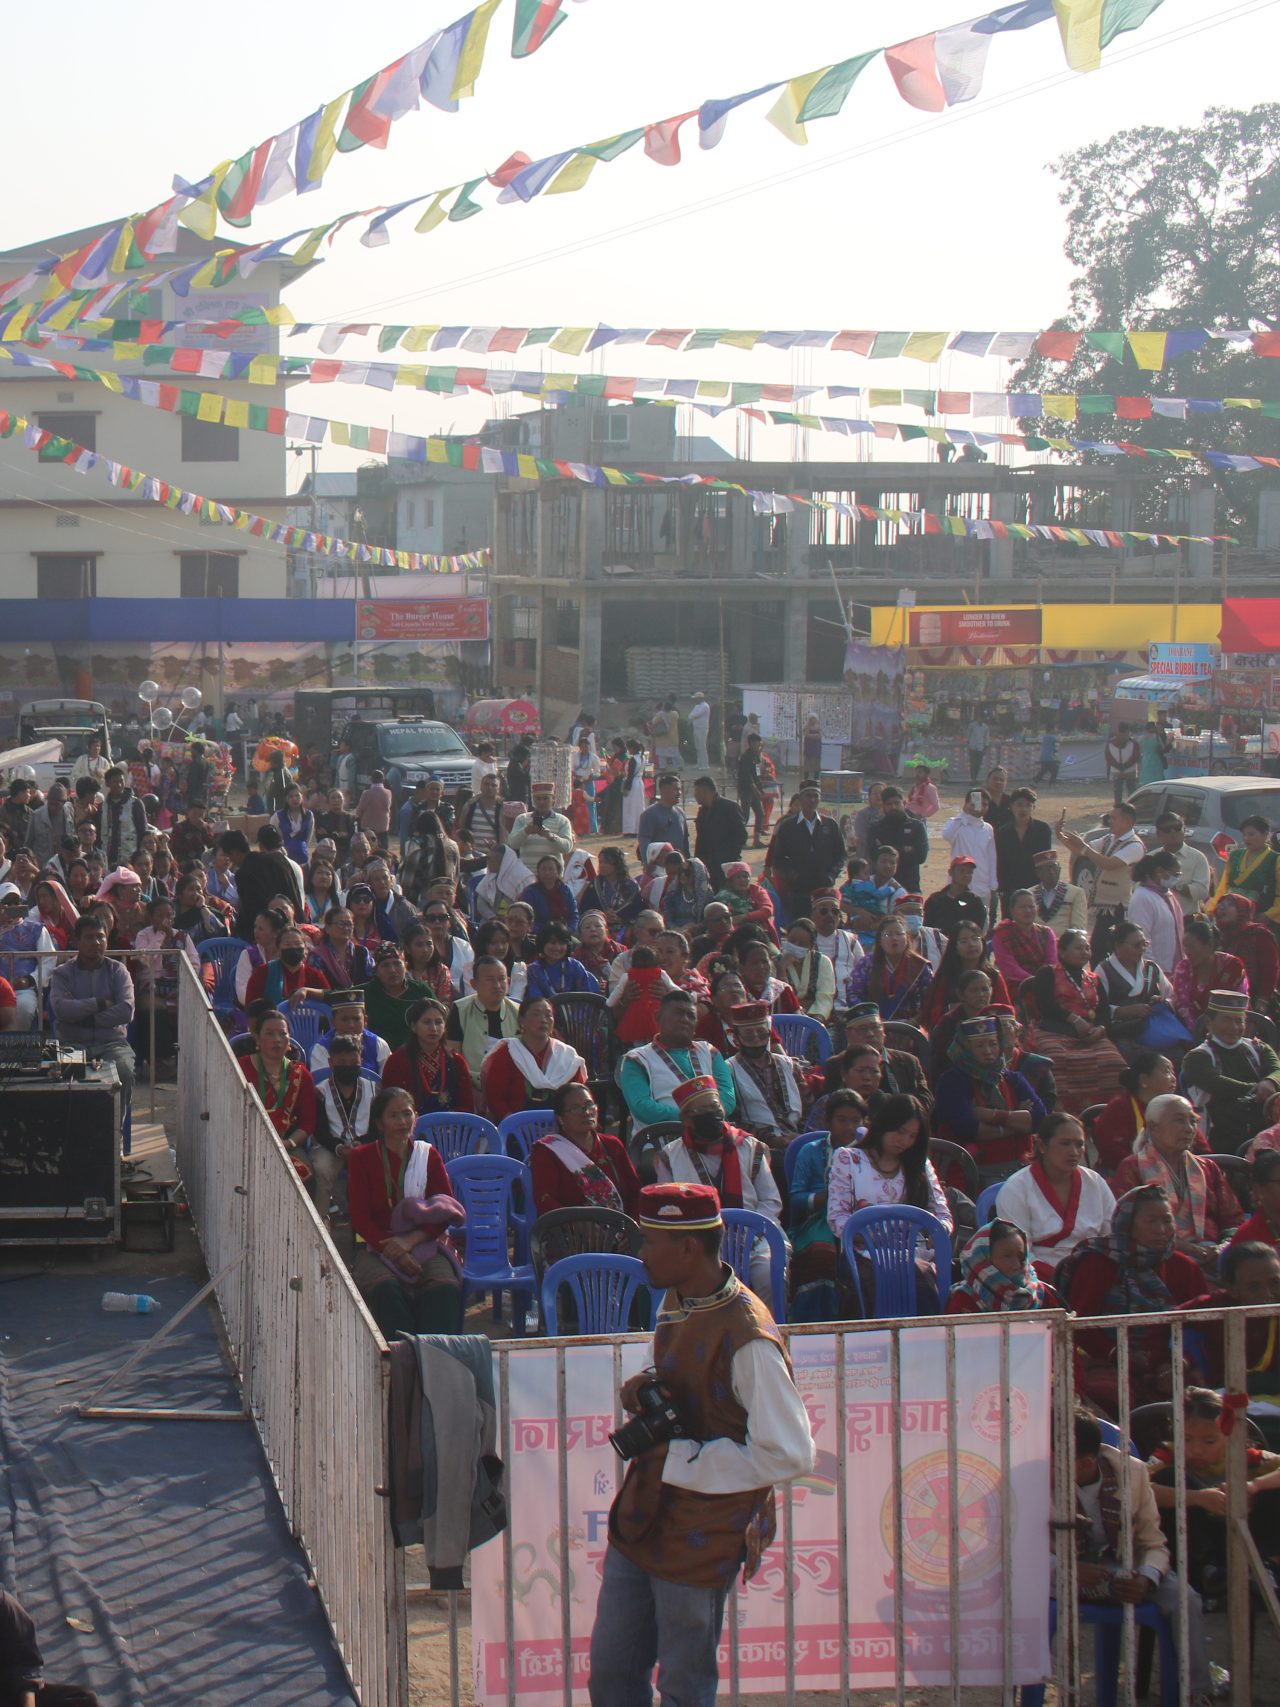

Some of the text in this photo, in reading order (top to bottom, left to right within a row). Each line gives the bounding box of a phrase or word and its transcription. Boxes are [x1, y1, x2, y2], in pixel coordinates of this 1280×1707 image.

[1151, 662, 1212, 675] SPECIAL BUBBLE TEA
